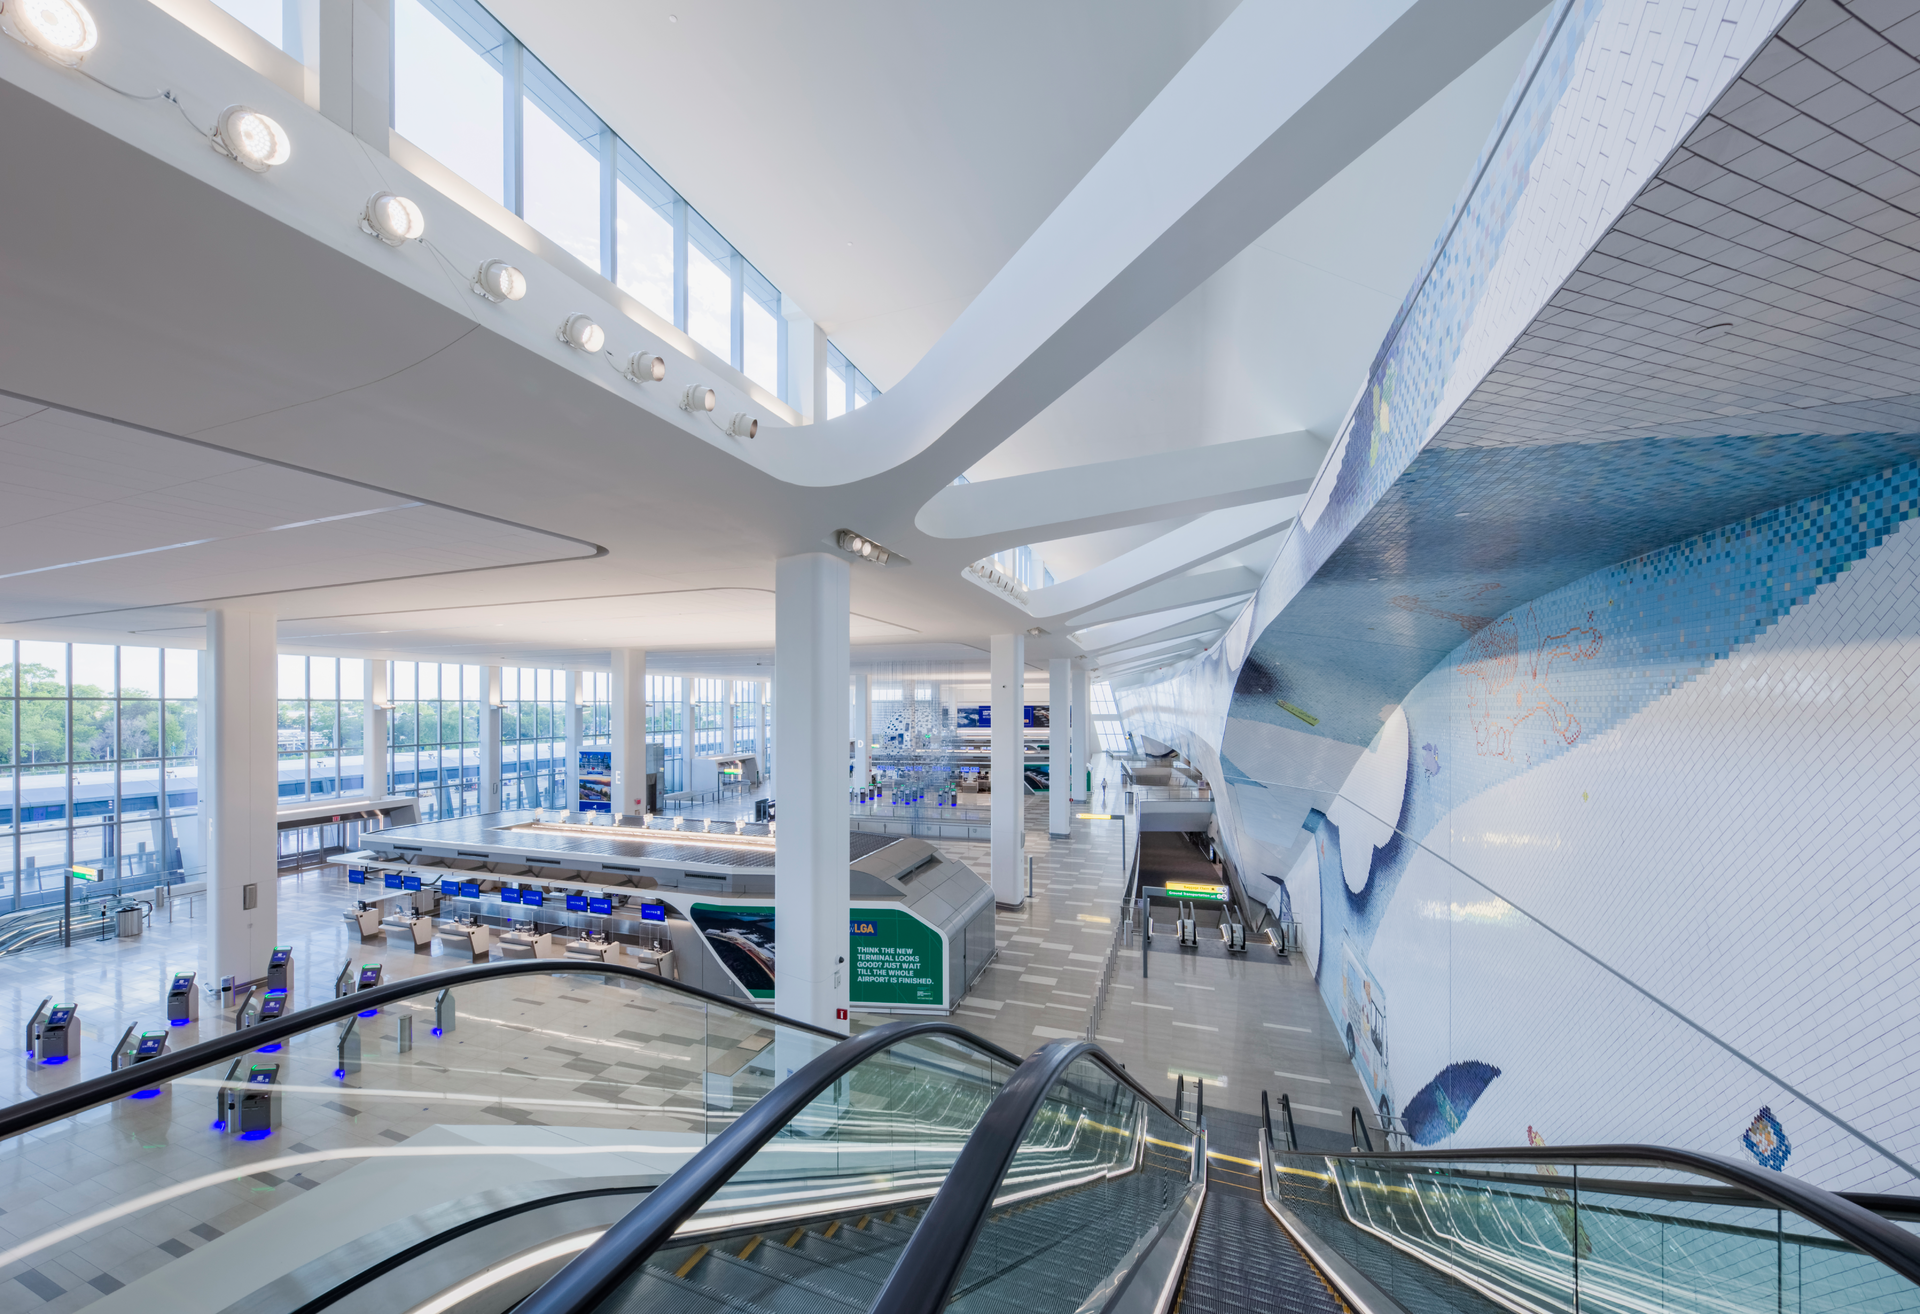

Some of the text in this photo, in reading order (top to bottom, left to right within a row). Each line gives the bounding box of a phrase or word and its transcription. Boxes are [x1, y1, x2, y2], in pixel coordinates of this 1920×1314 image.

[857, 739, 864, 748] D
[615, 770, 621, 784] E
[854, 923, 874, 933] LGA
[857, 946, 880, 954] THINK
[898, 977, 934, 985] FINISHED.
